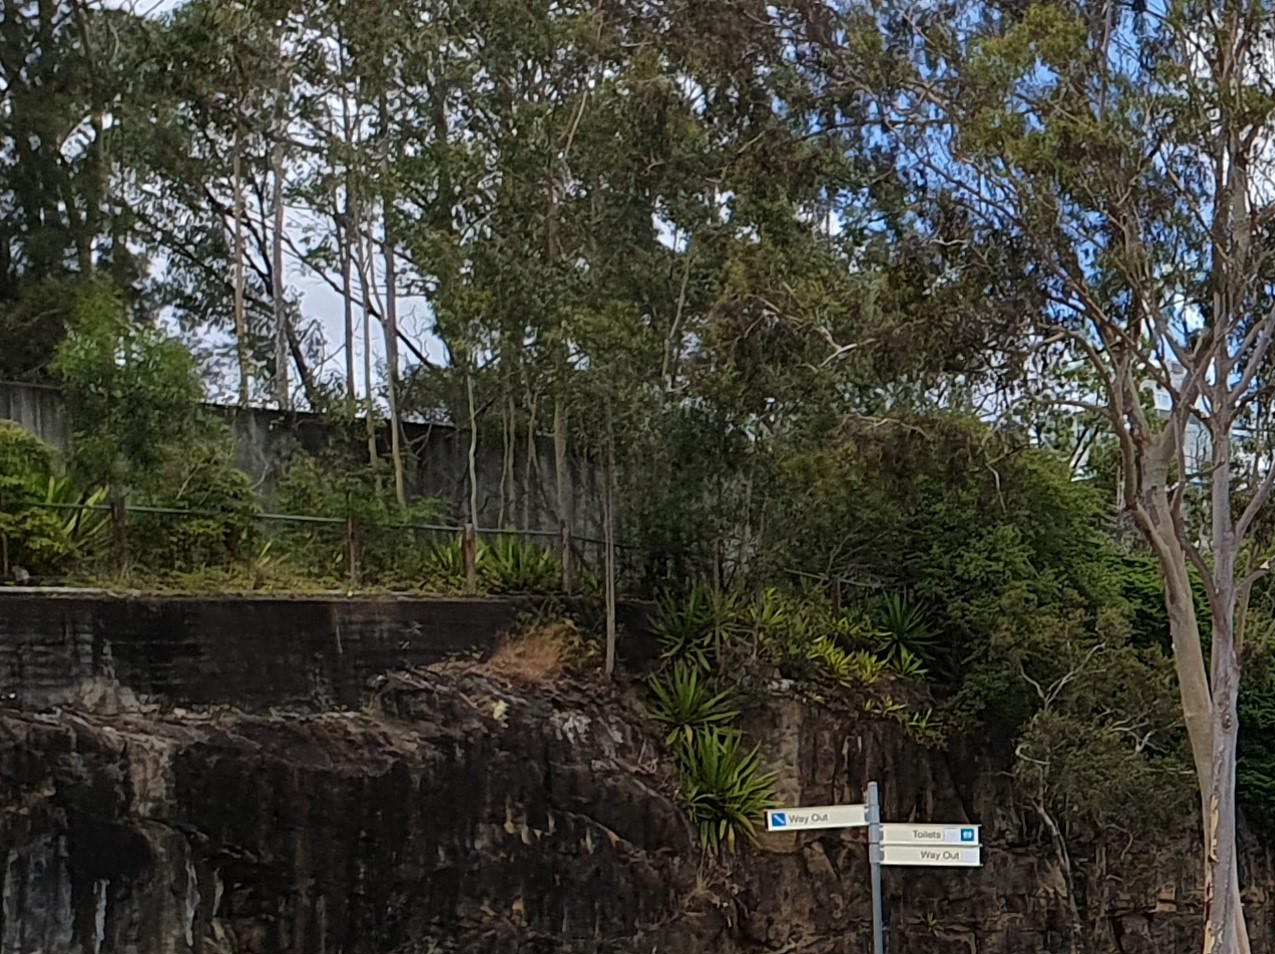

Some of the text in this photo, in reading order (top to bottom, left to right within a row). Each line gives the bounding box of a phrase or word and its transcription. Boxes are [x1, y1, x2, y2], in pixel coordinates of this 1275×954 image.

[789, 813, 828, 824] Way Out
[913, 830, 941, 838] Toilets
[920, 850, 959, 861] Way Out
